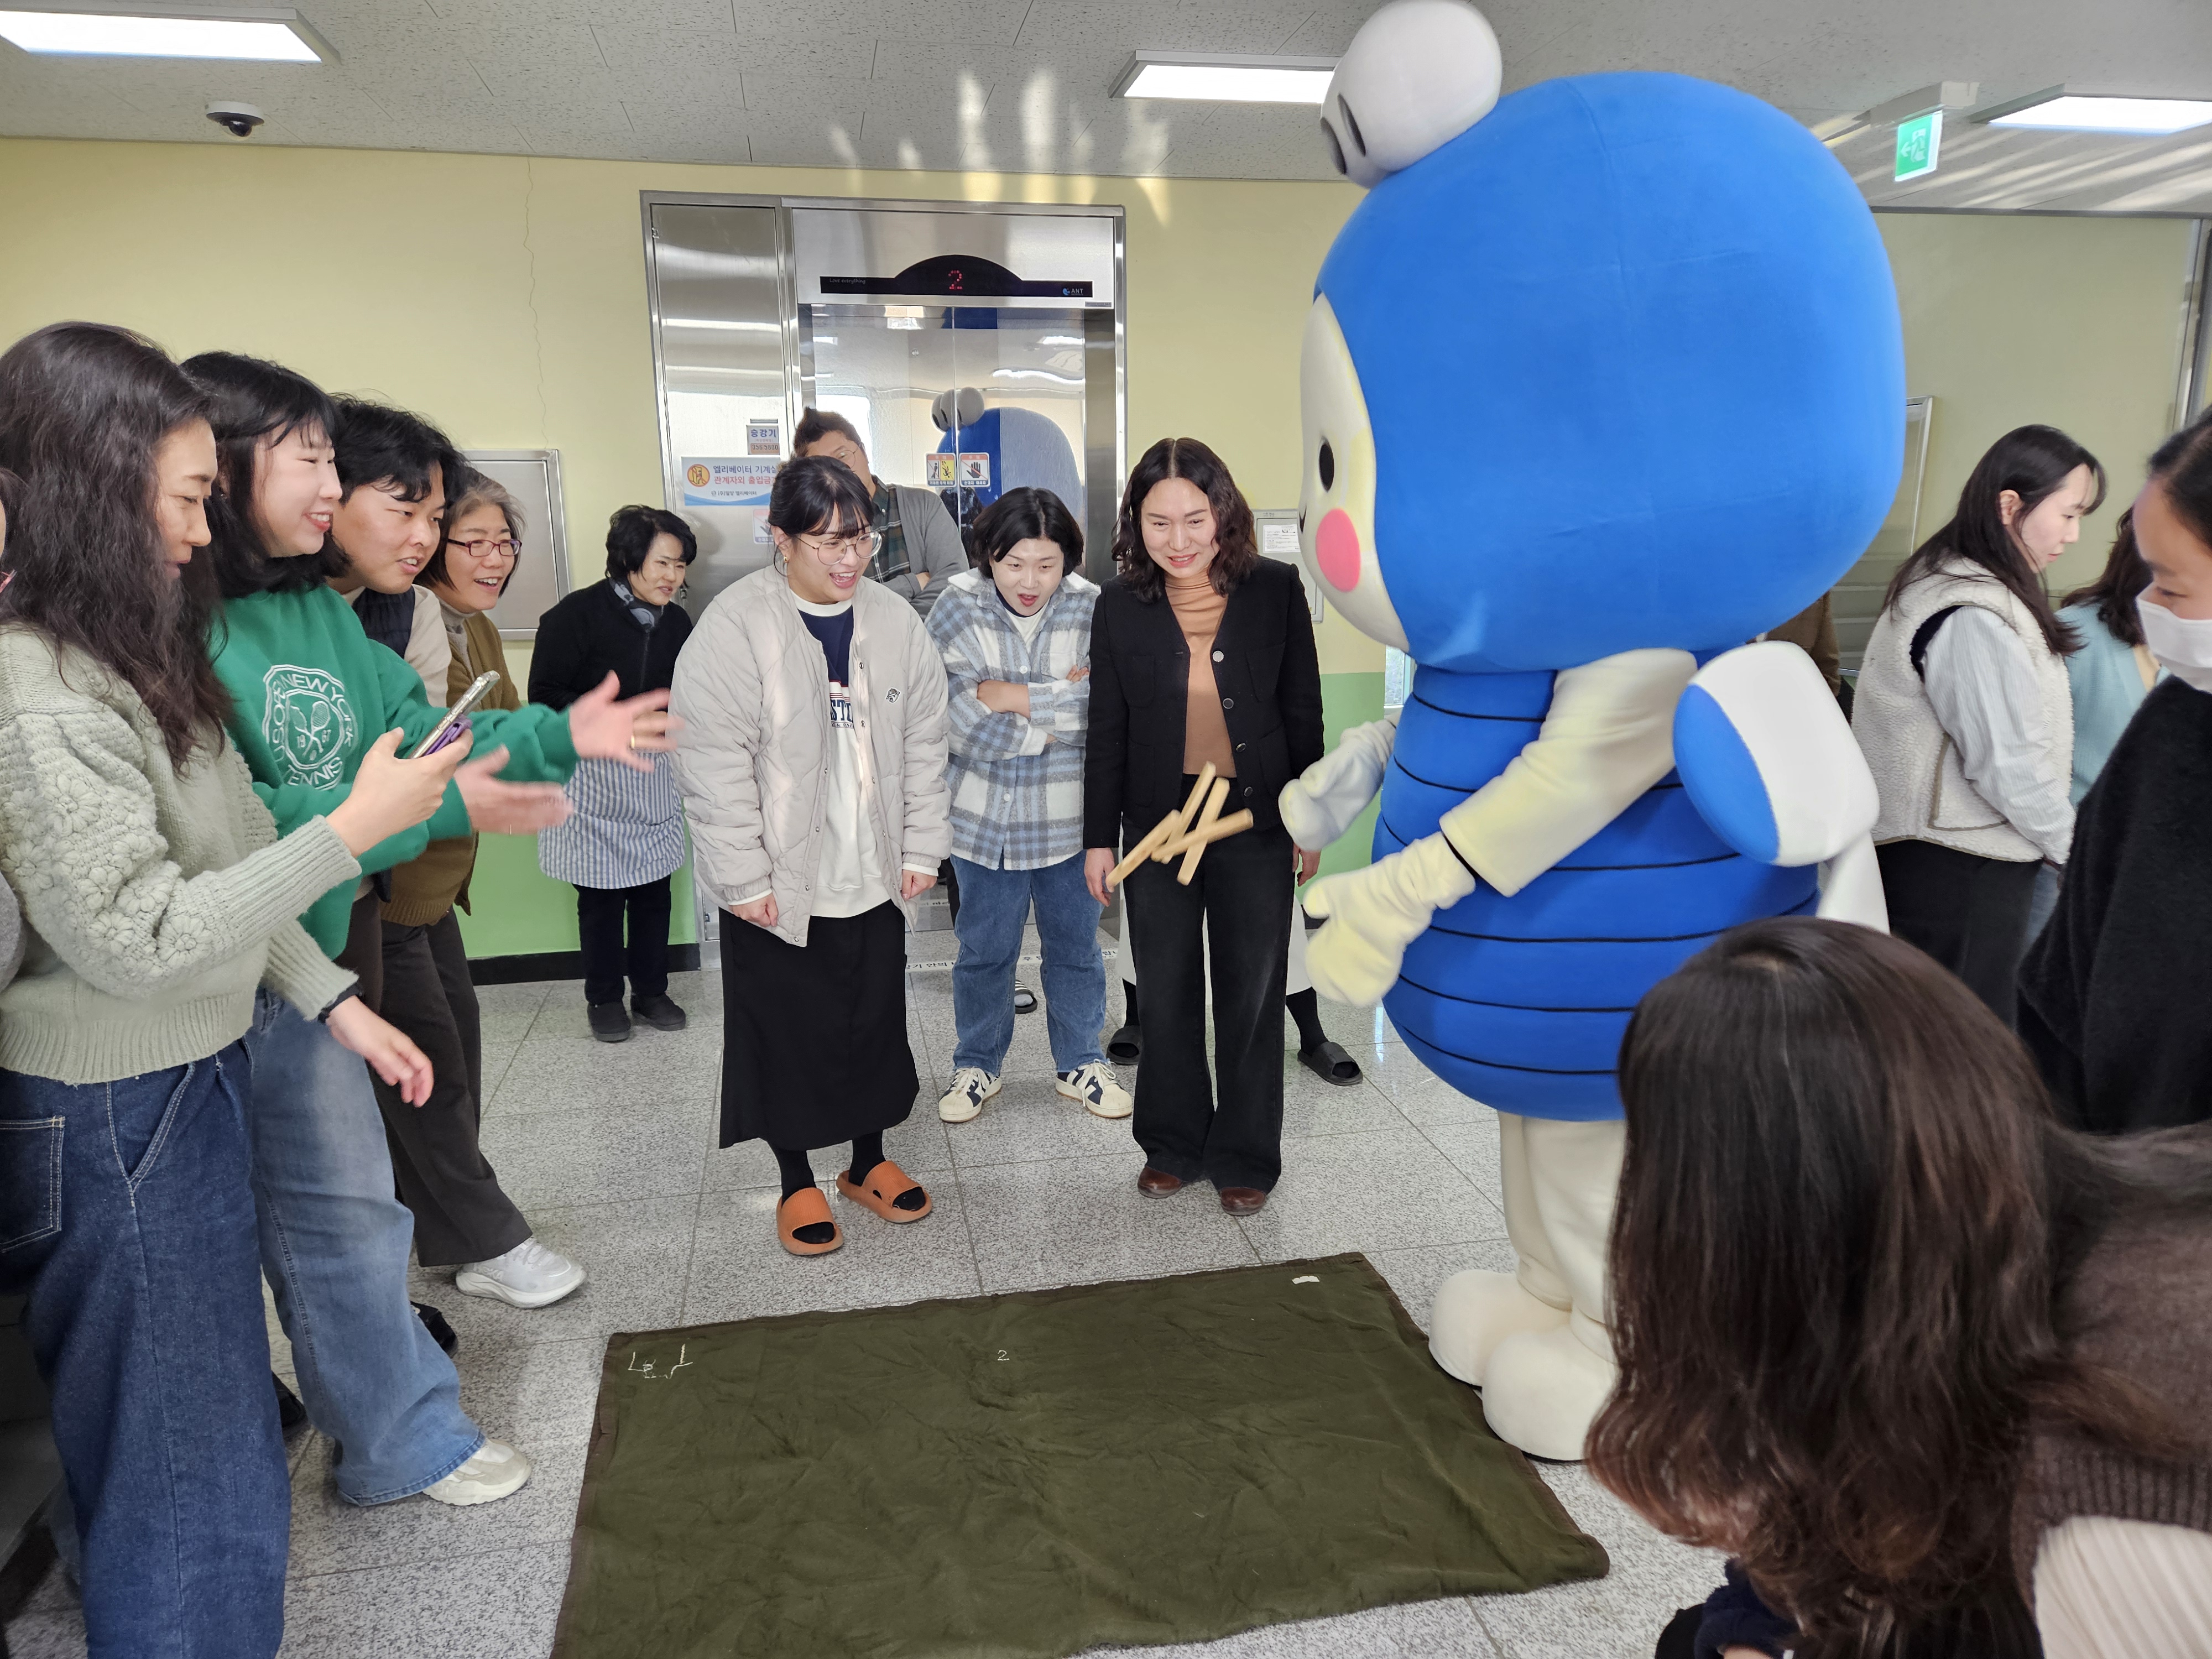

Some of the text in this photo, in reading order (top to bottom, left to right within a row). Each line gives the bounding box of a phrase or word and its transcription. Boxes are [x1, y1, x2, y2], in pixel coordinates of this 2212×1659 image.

[948, 270, 963, 290] 2
[750, 429, 776, 437] 승강기
[713, 465, 752, 474] 엘리베이터
[714, 476, 745, 484] 관계자외
[279, 674, 329, 693] NEW
[282, 757, 343, 785] TENNIS
[997, 1349, 1010, 1361] 2
